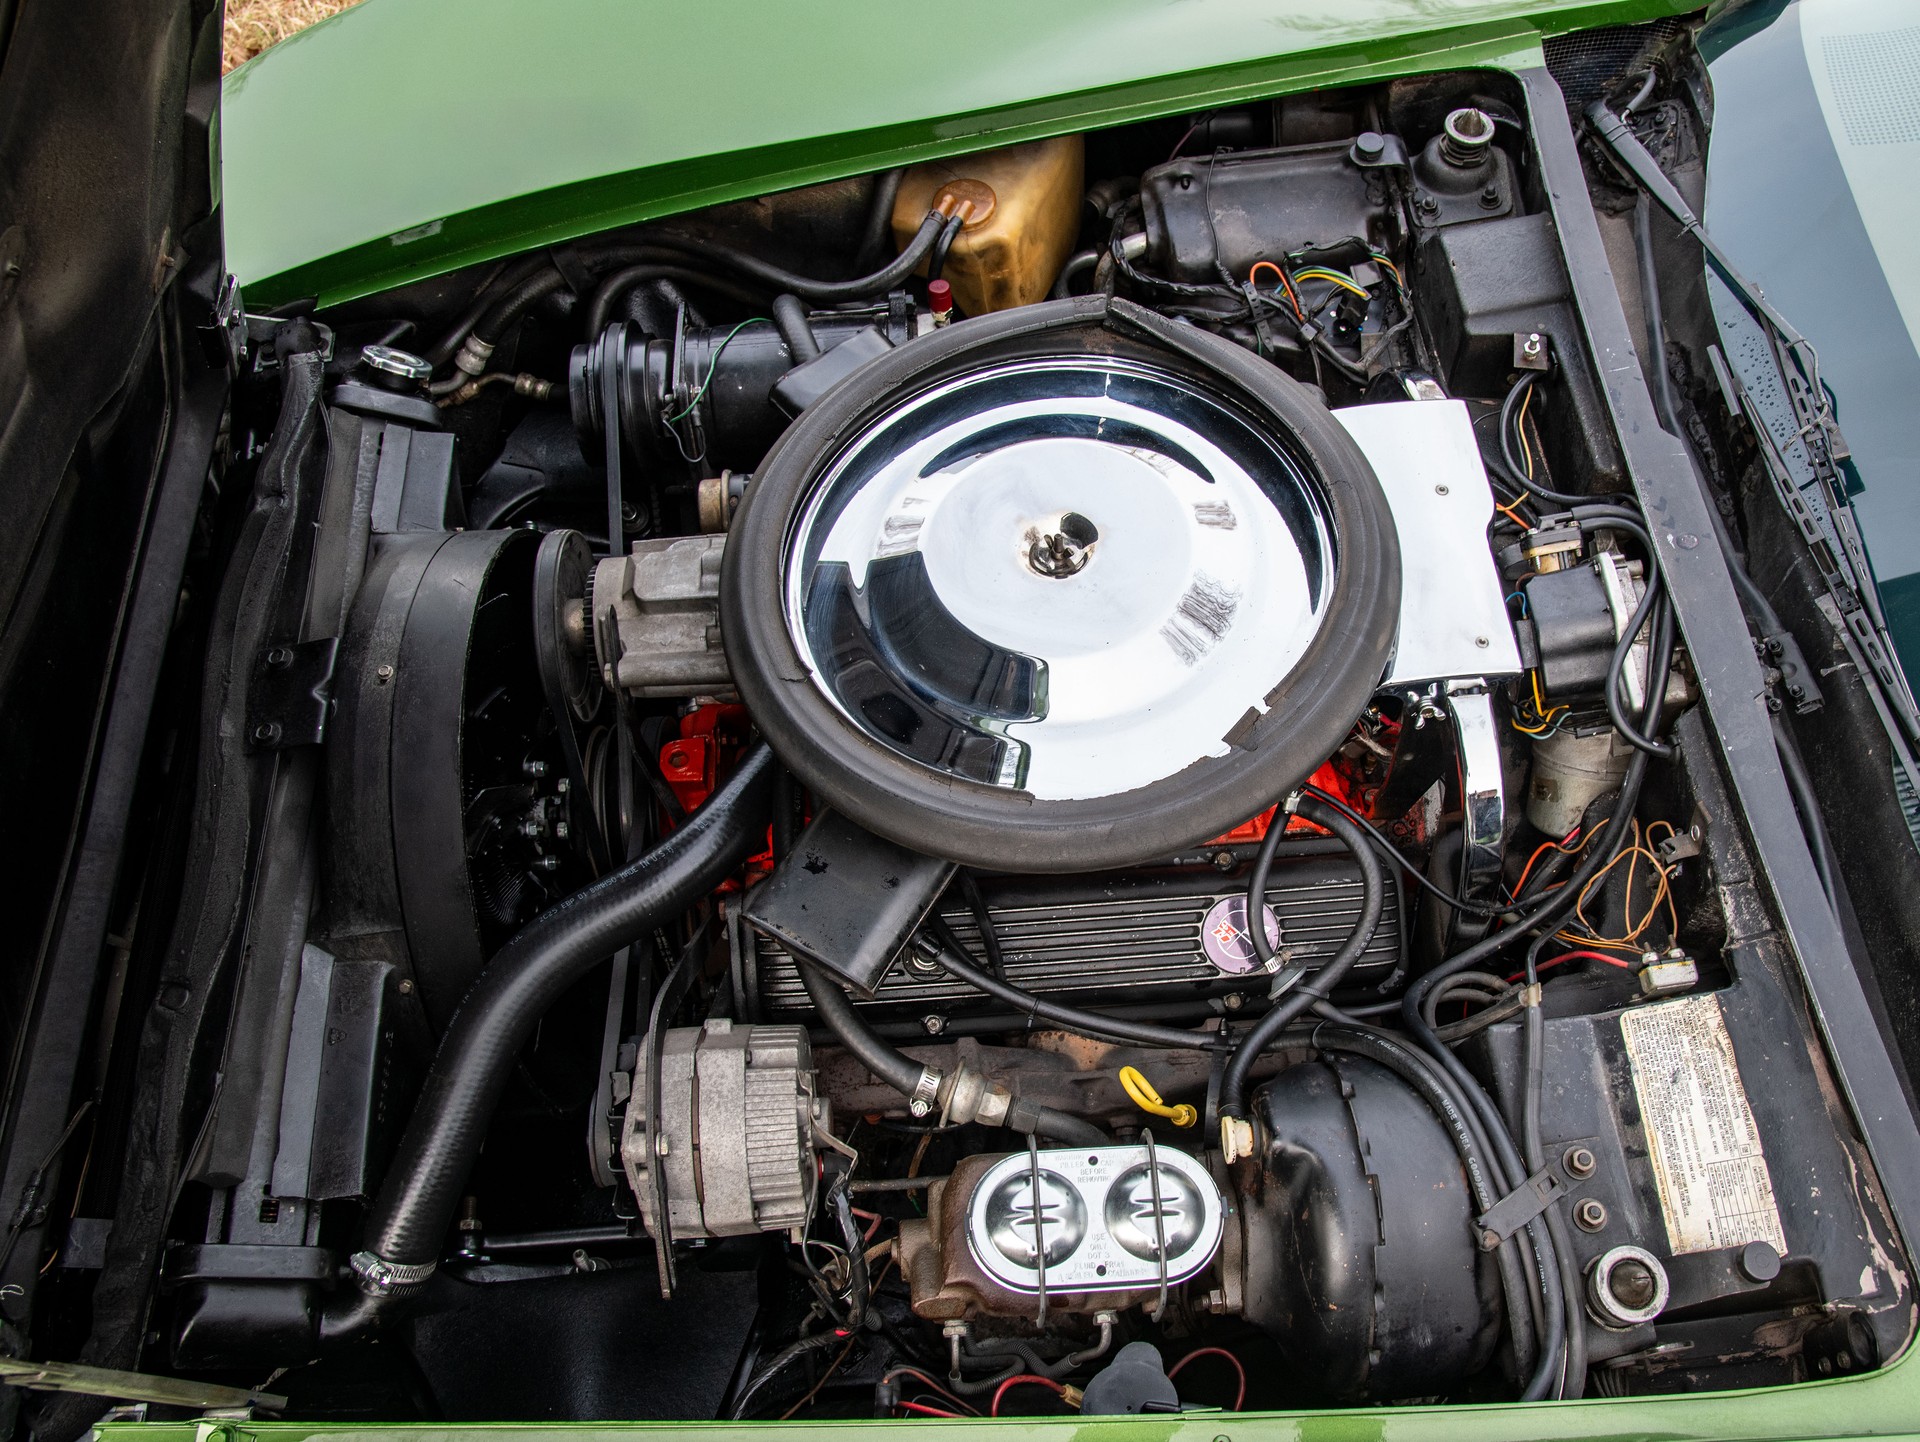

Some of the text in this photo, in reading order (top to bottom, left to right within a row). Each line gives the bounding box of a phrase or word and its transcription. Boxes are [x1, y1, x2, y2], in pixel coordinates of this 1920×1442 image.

[619, 865, 639, 880] MADE
[640, 859, 650, 869] IN
[1723, 1068, 1732, 1087] MOTORS
[1727, 1088, 1740, 1119] CORPORATION
[1732, 1071, 1744, 1097] CONTROL
[1739, 1100, 1755, 1141] INFORMATION
[1442, 1098, 1457, 1120] MADE
[1454, 1121, 1462, 1131] IN
[1459, 1132, 1470, 1150] USA
[1468, 1156, 1491, 1210] GOODYEAR
[1078, 1175, 1111, 1183] REMOVING
[1090, 1243, 1107, 1251] ONLY
